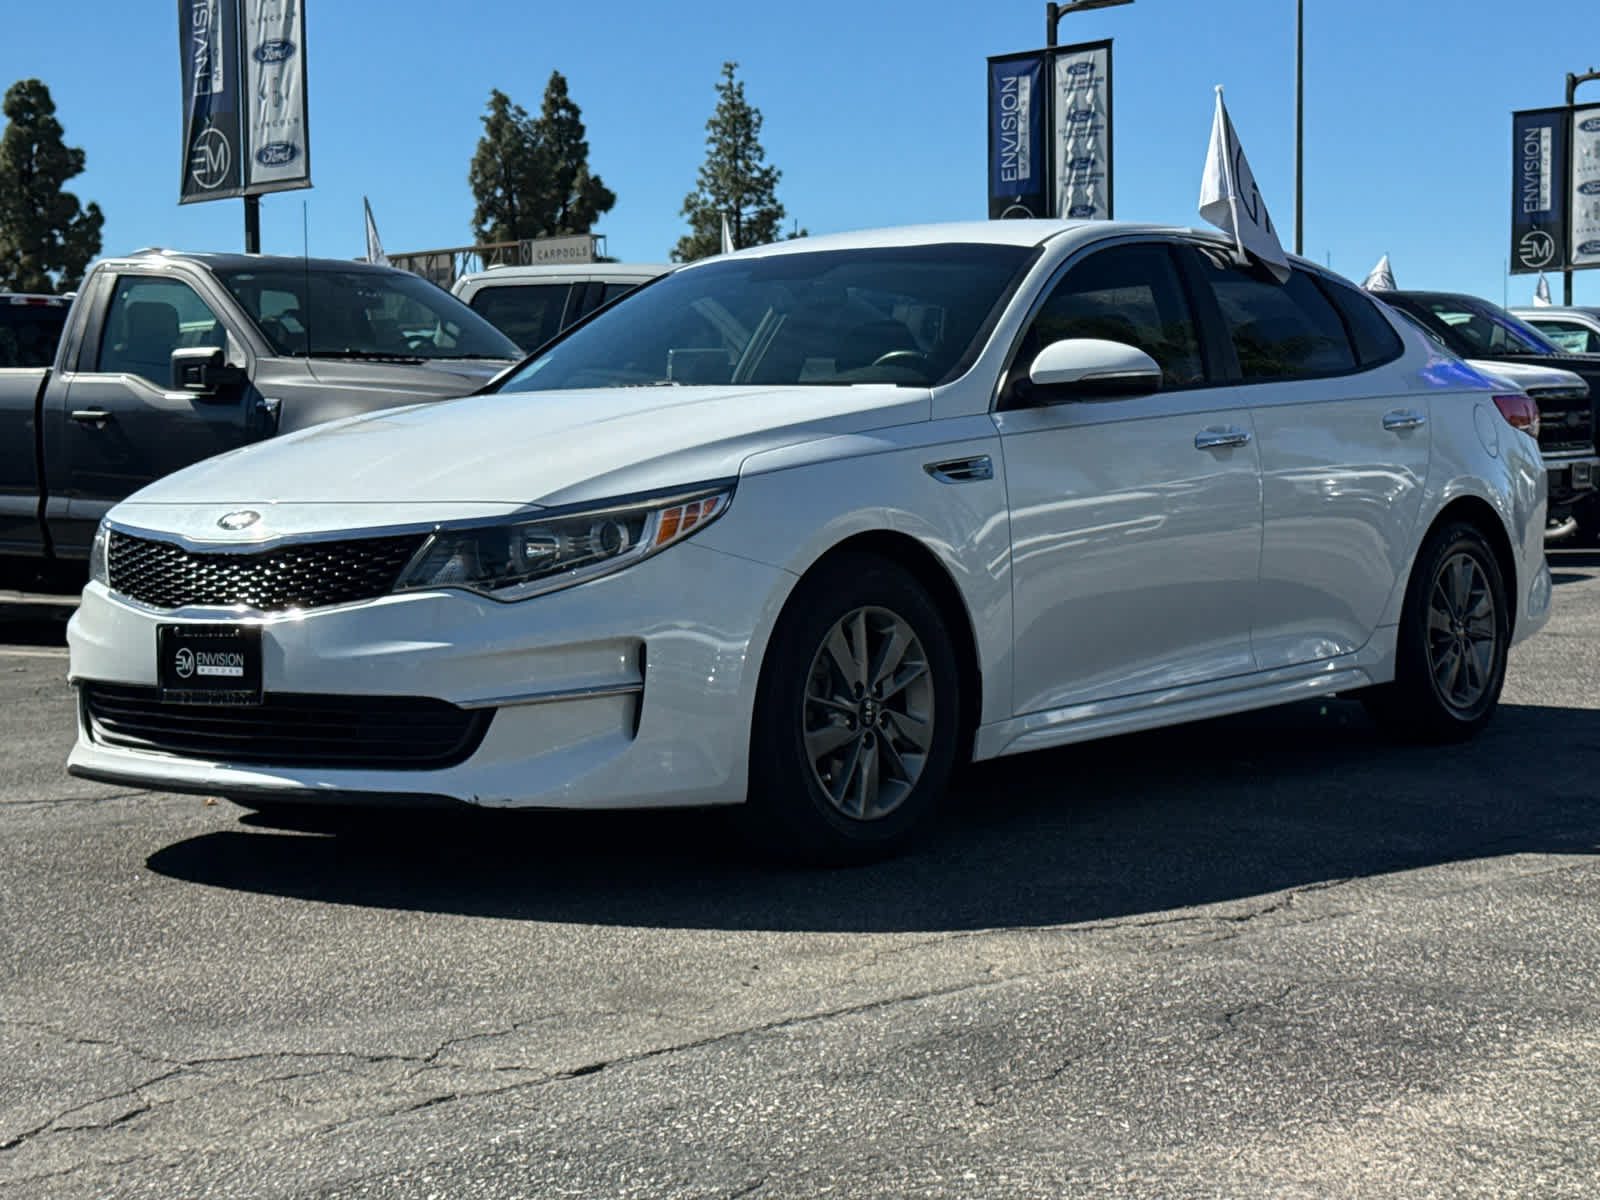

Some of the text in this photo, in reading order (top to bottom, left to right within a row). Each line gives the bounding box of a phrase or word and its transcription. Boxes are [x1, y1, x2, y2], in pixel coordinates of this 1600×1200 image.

[192, 0, 211, 96] ENVISI
[1001, 76, 1017, 183] ENVISION
[1523, 127, 1540, 213] ENVISION
[537, 244, 588, 260] CARPOOLS
[196, 651, 244, 665] ENVISION
